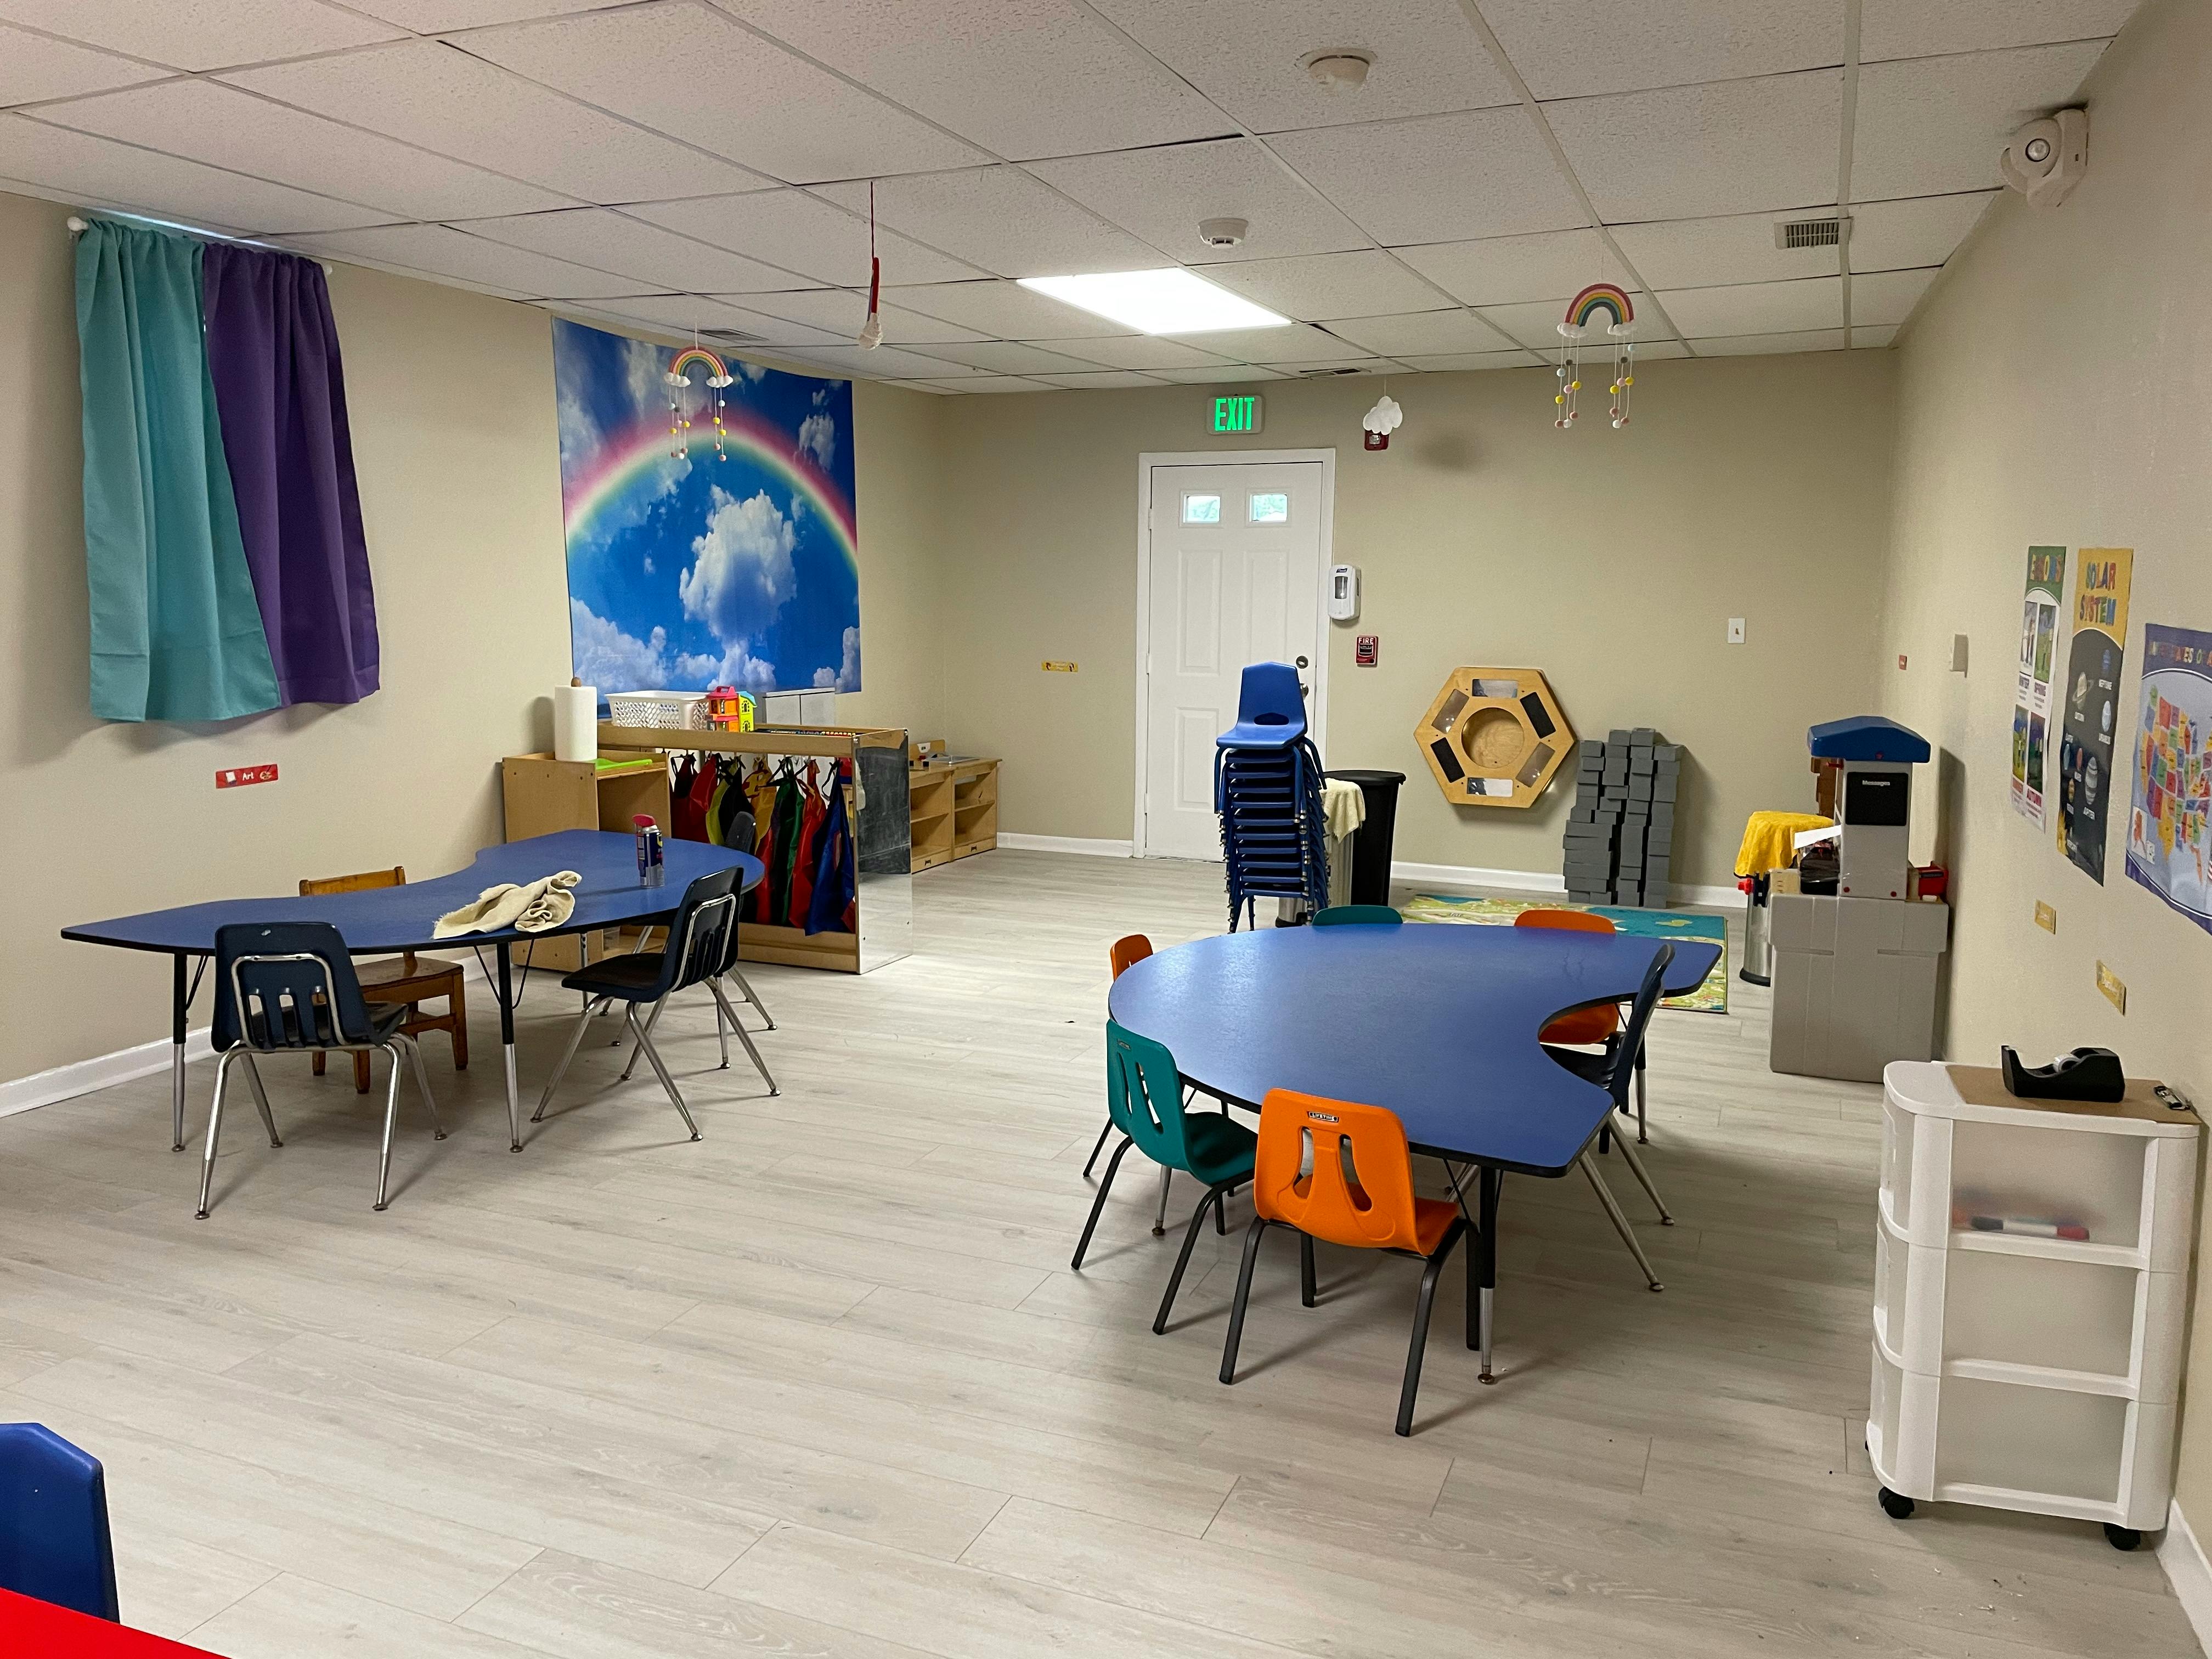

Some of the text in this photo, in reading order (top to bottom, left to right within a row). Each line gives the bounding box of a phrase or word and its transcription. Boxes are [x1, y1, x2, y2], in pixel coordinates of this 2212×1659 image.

[1215, 397, 1255, 431] EXIT
[2085, 561, 2117, 591] SOLAR
[2079, 594, 2117, 627] SYSTEM
[242, 771, 254, 781] Art
